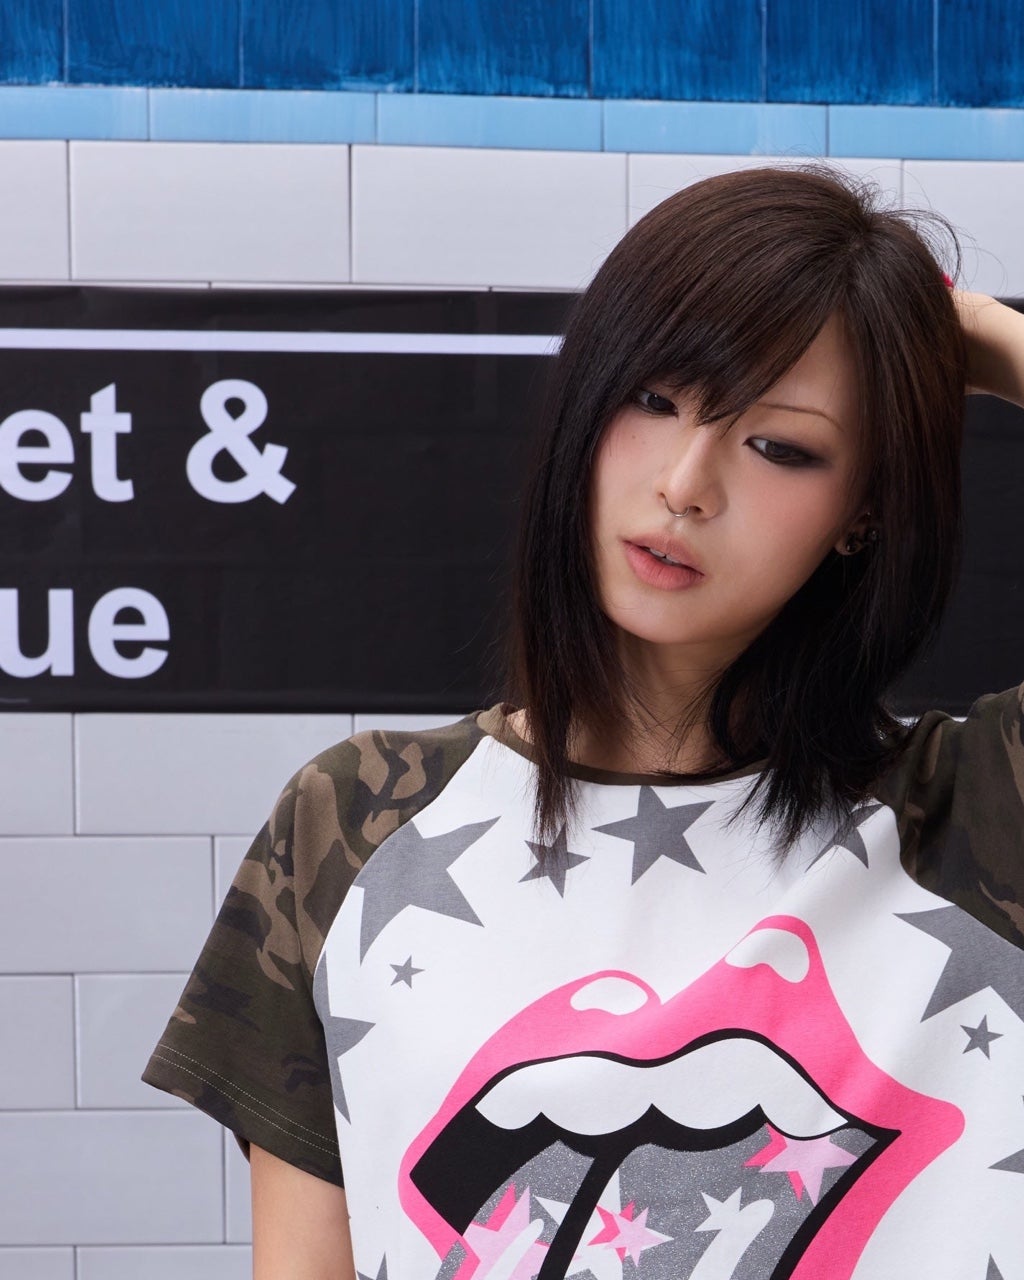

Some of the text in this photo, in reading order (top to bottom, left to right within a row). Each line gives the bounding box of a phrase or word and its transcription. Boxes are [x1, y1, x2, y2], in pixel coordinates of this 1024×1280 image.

[0, 378, 297, 505] et &
[0, 586, 170, 679] ue
